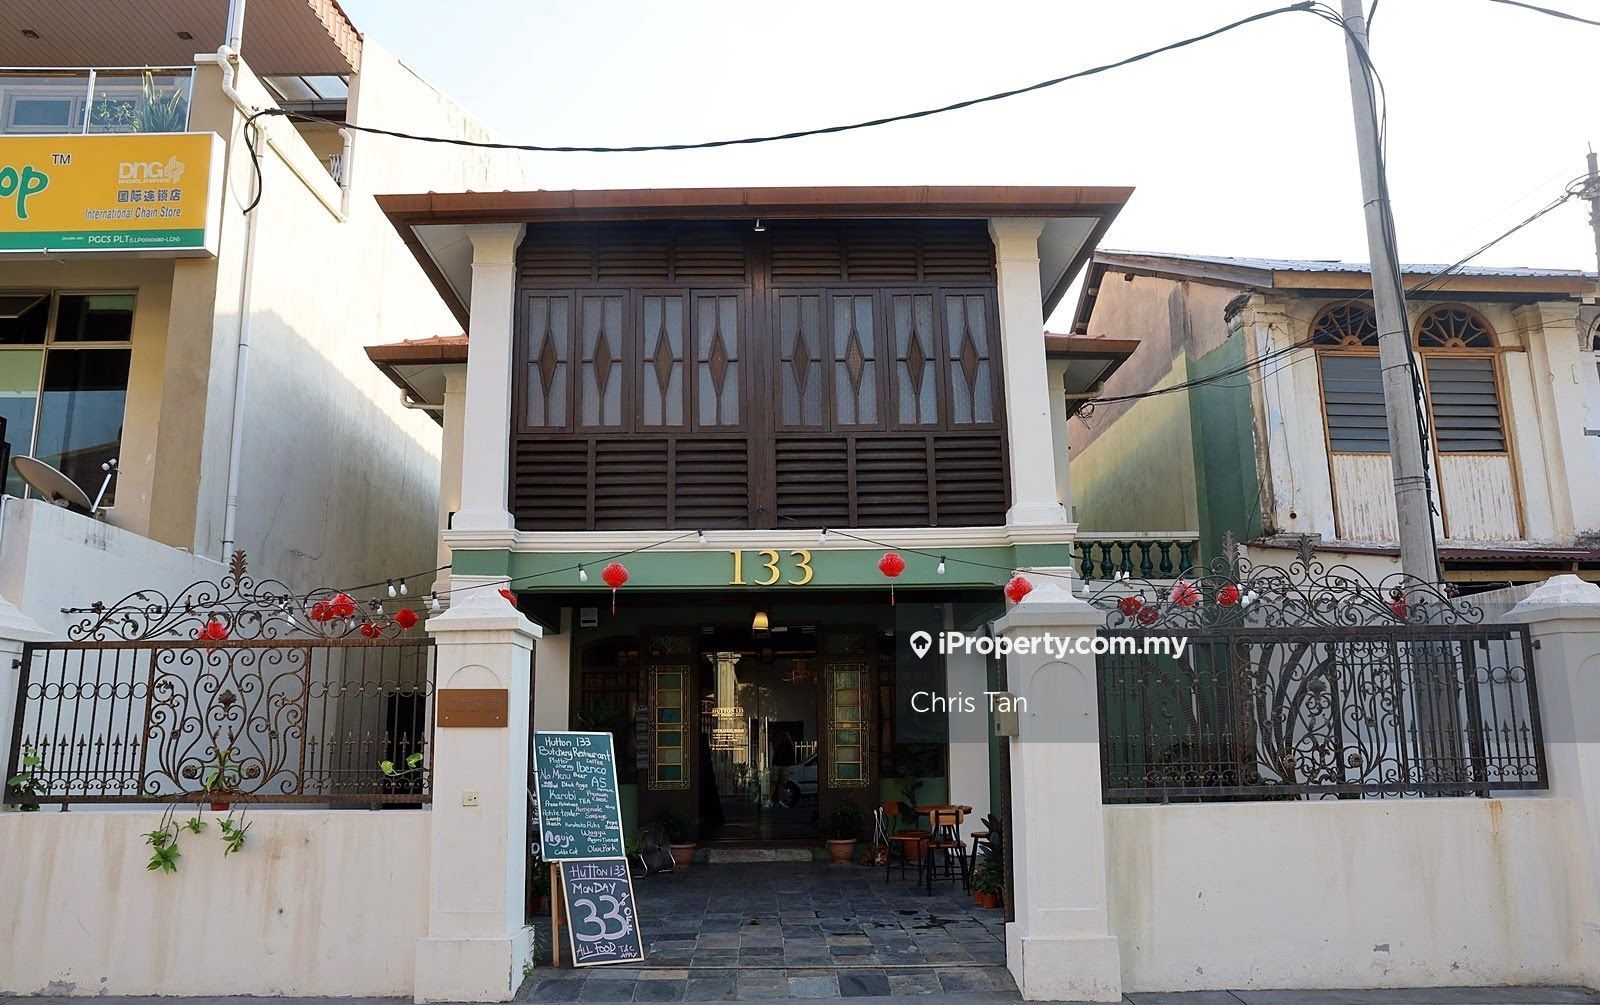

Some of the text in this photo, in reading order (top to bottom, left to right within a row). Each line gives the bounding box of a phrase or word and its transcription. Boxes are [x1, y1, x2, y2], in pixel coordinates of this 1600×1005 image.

[51, 154, 71, 165] TM
[117, 188, 181, 203] 国际连锁店
[85, 206, 181, 220] International Chain Store
[88, 235, 111, 244] PGCS
[113, 234, 129, 244] PLT
[729, 549, 814, 586] 133
[545, 737, 592, 747] Hutton 133
[538, 745, 611, 762] Butchery Restaurant
[540, 768, 571, 780] No Menu
[610, 865, 626, 877] 133
[576, 944, 593, 957] ALL
